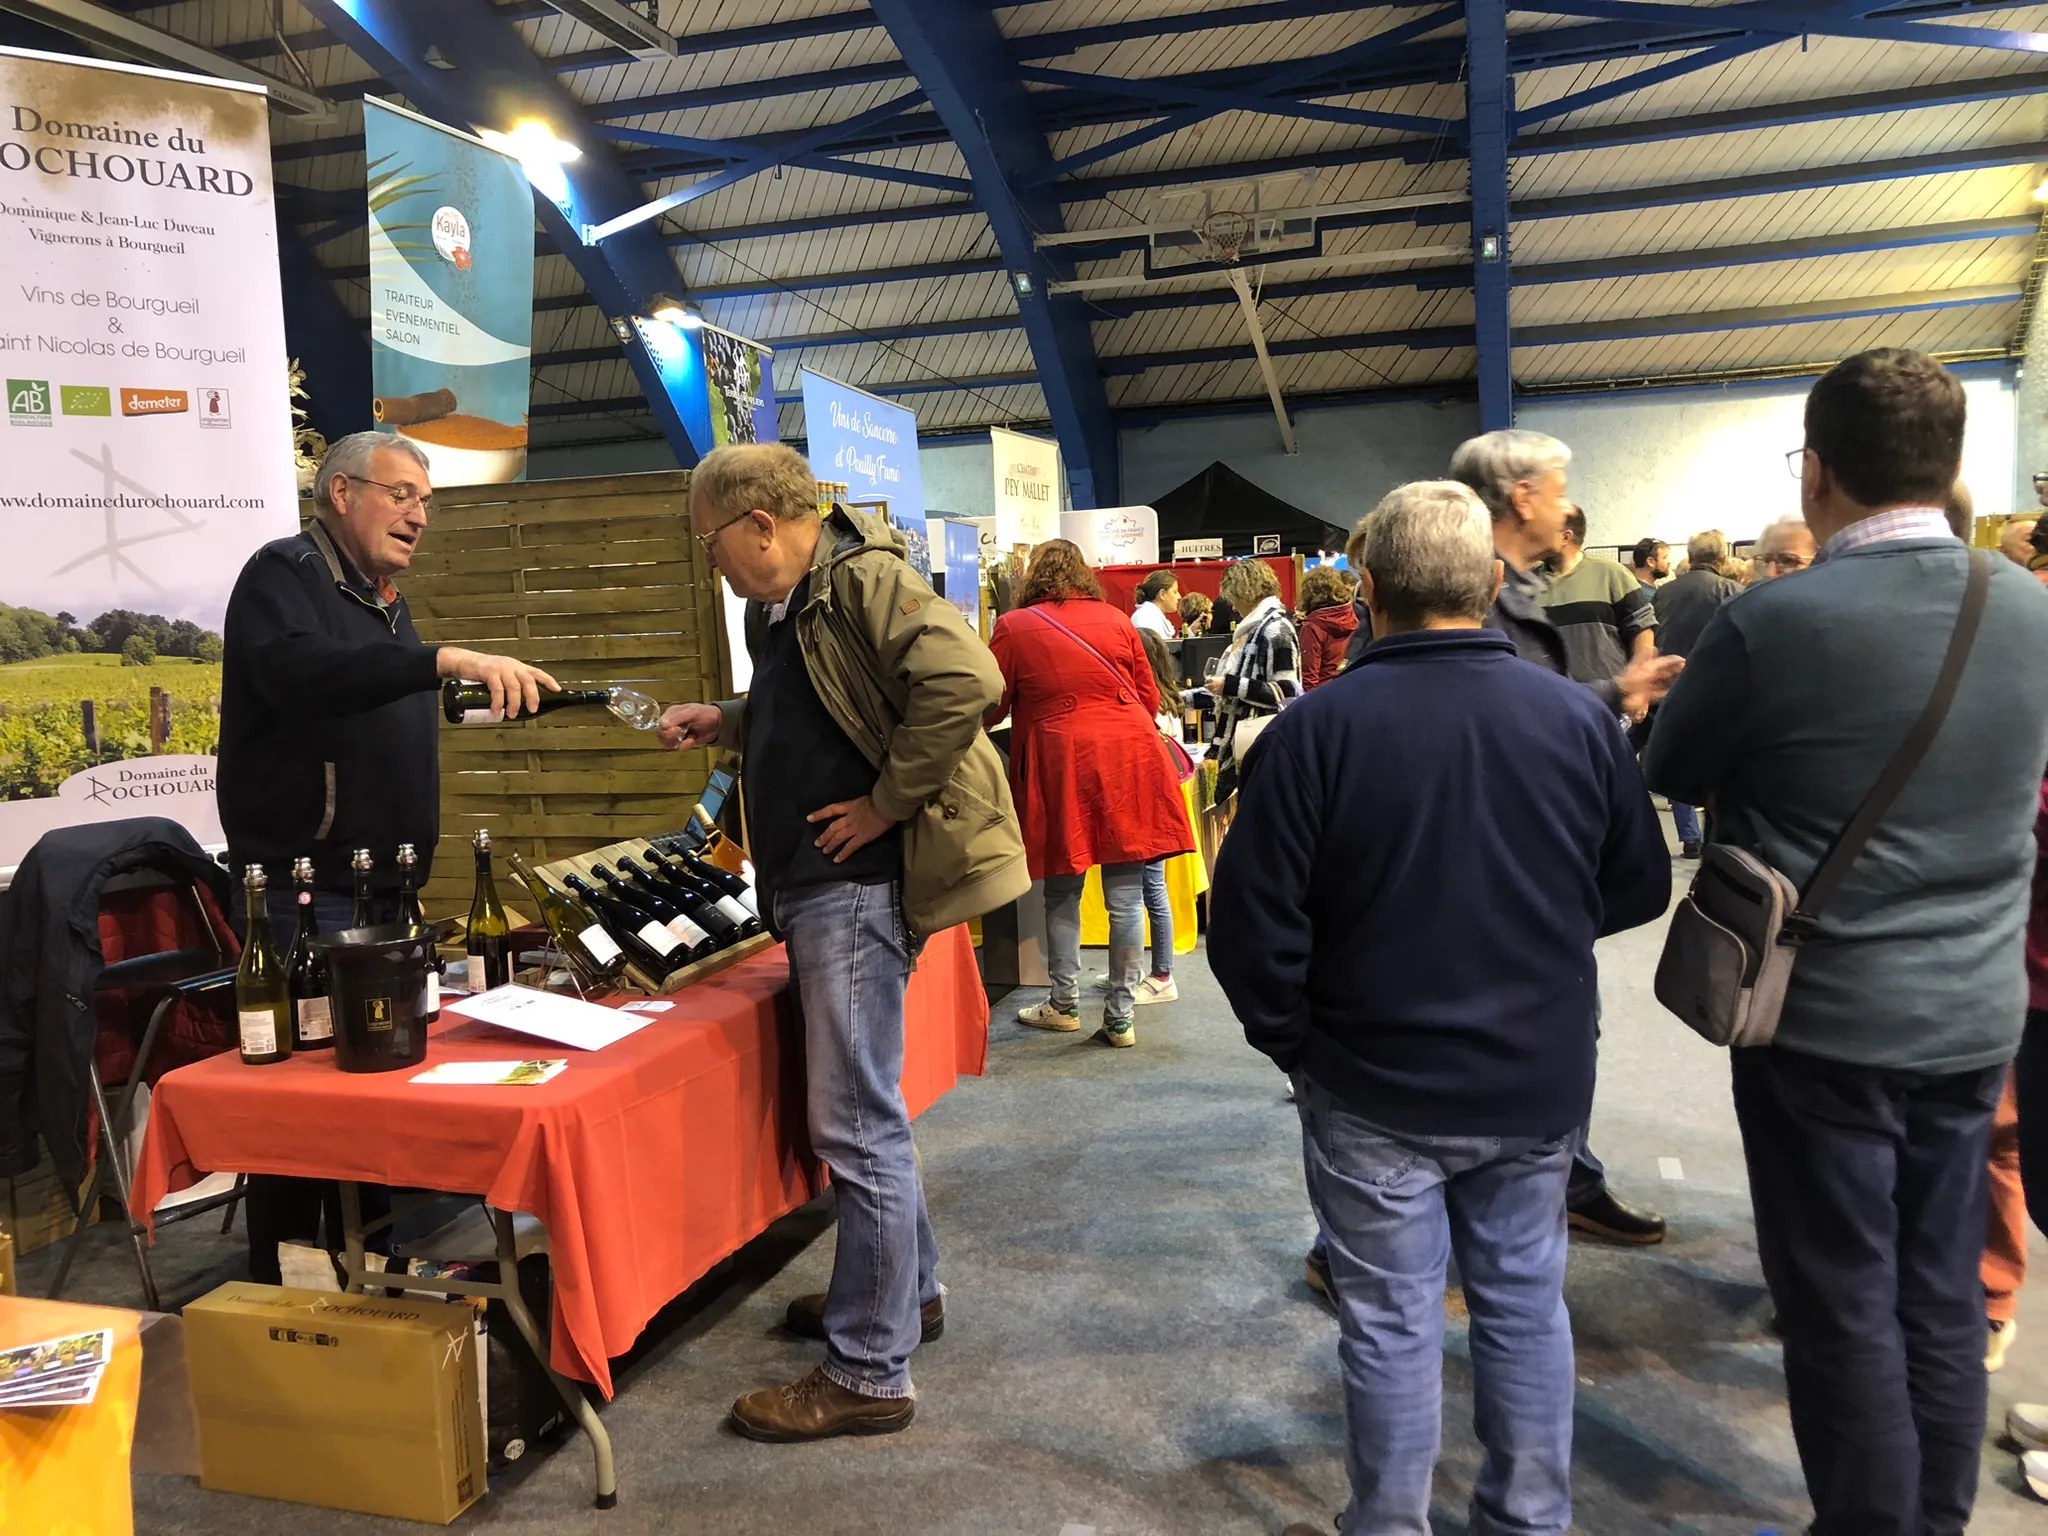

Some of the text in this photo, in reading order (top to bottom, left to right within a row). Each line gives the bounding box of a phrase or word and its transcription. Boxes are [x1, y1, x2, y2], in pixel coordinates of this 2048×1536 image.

[10, 105, 206, 154] Domaine du
[0, 142, 254, 196] OCHOUARD
[80, 210, 94, 223] &
[96, 211, 160, 230] Jean-Luc
[163, 218, 216, 235] Duveau
[436, 214, 466, 238] Kayla
[28, 227, 186, 255] Vignerons à Bourgueil
[21, 285, 200, 316] Vins de Bourgueil
[385, 289, 434, 311] TRAITEUR
[107, 316, 124, 334] &
[385, 309, 461, 336] EVENEMENTIEL
[0, 333, 246, 366] int Nicolas de Bourgueil
[385, 328, 421, 346] SALON
[11, 389, 45, 413] AB
[128, 394, 182, 410] demeter
[830, 400, 898, 445] Vins de Sancerre
[835, 445, 900, 487] et Pouilly Fumé
[0, 493, 266, 509] ww.domainedurochouard.com
[1004, 477, 1050, 502] PEY MALLET
[119, 764, 208, 782] Domaine du
[83, 776, 217, 808] ROCHOUAR
